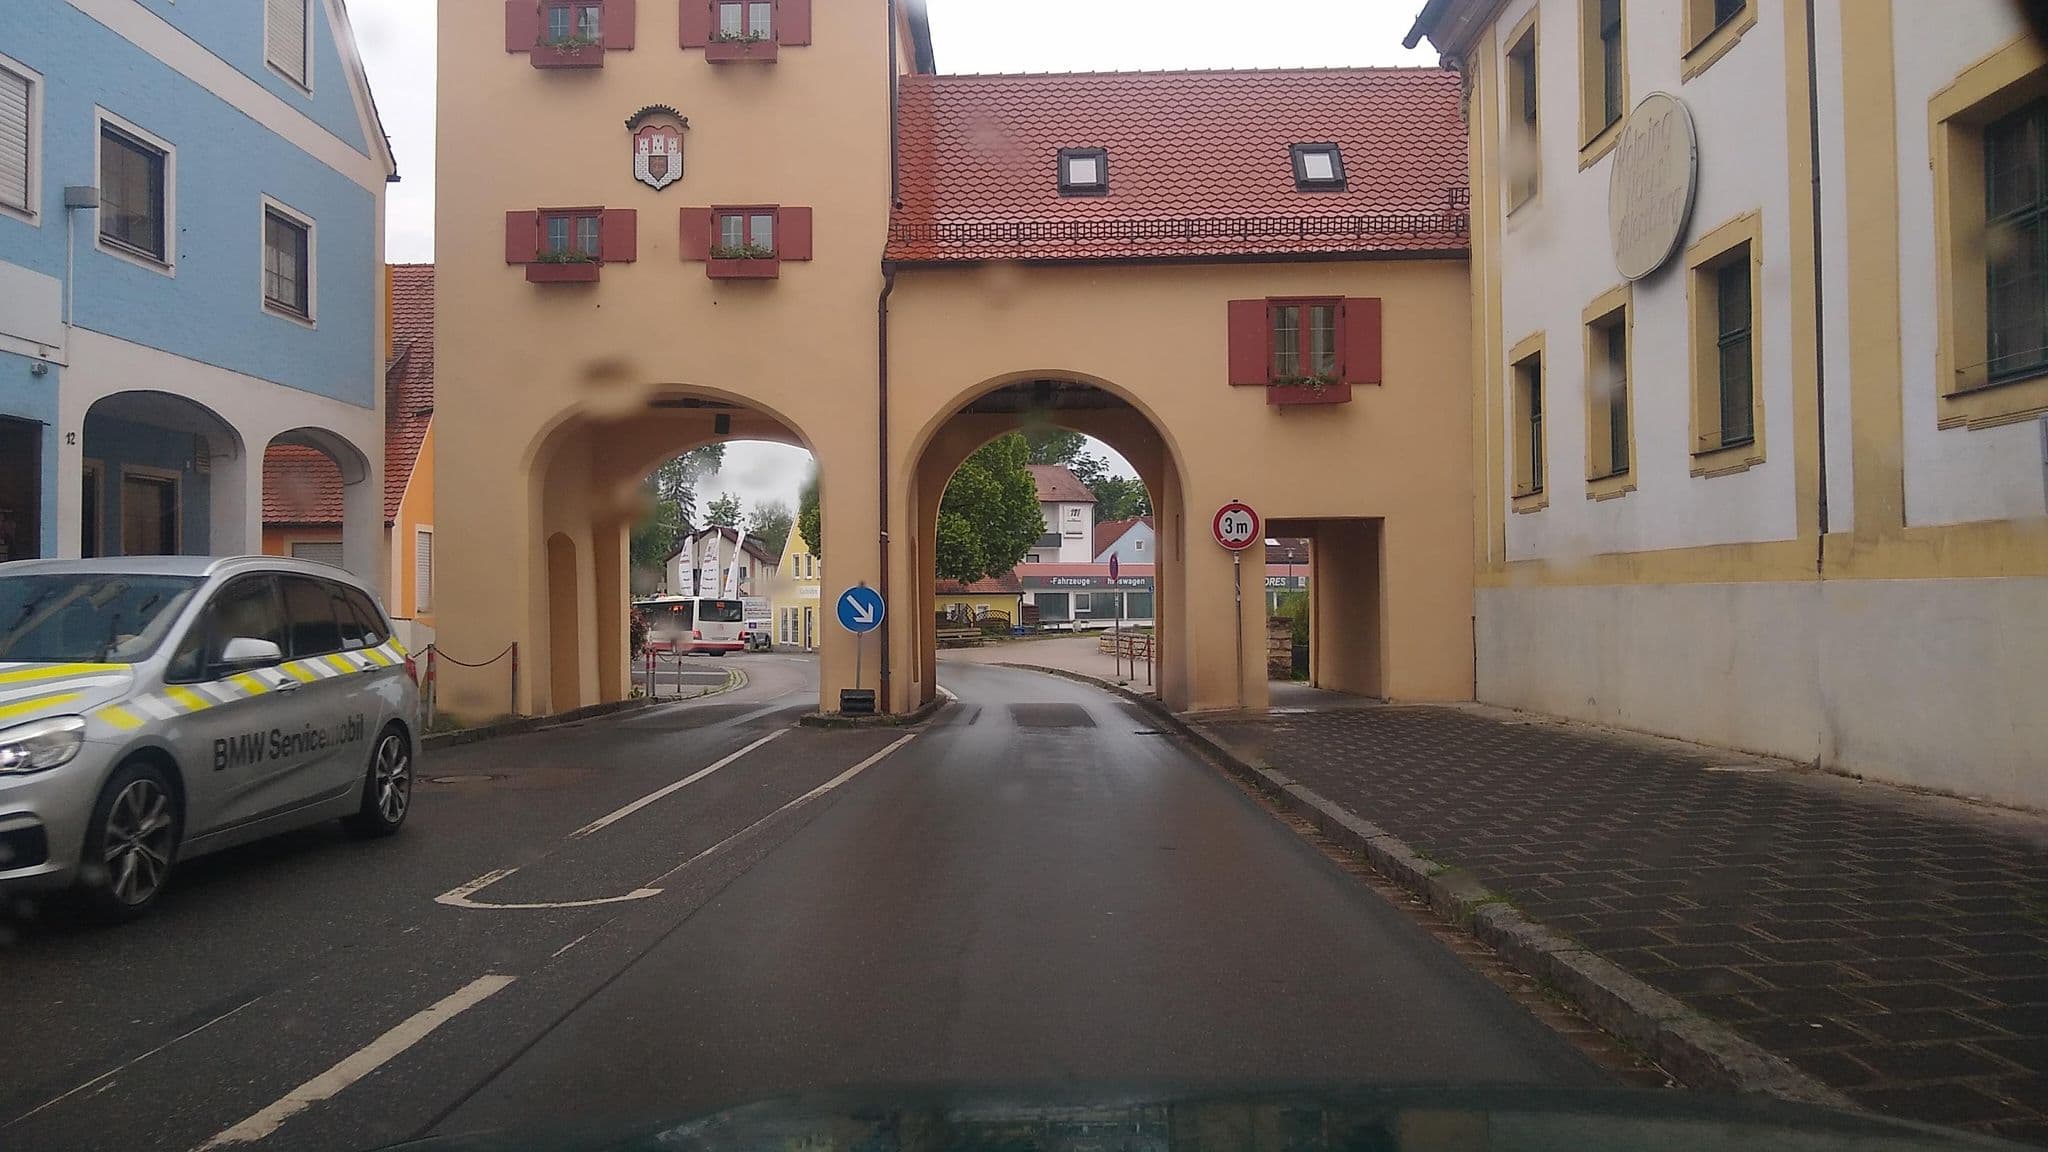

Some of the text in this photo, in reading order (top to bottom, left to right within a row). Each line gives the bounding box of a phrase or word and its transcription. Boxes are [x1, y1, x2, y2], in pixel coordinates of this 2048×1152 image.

[65, 431, 76, 445] 12
[1224, 517, 1248, 534] 3 m
[213, 731, 266, 771] BMW
